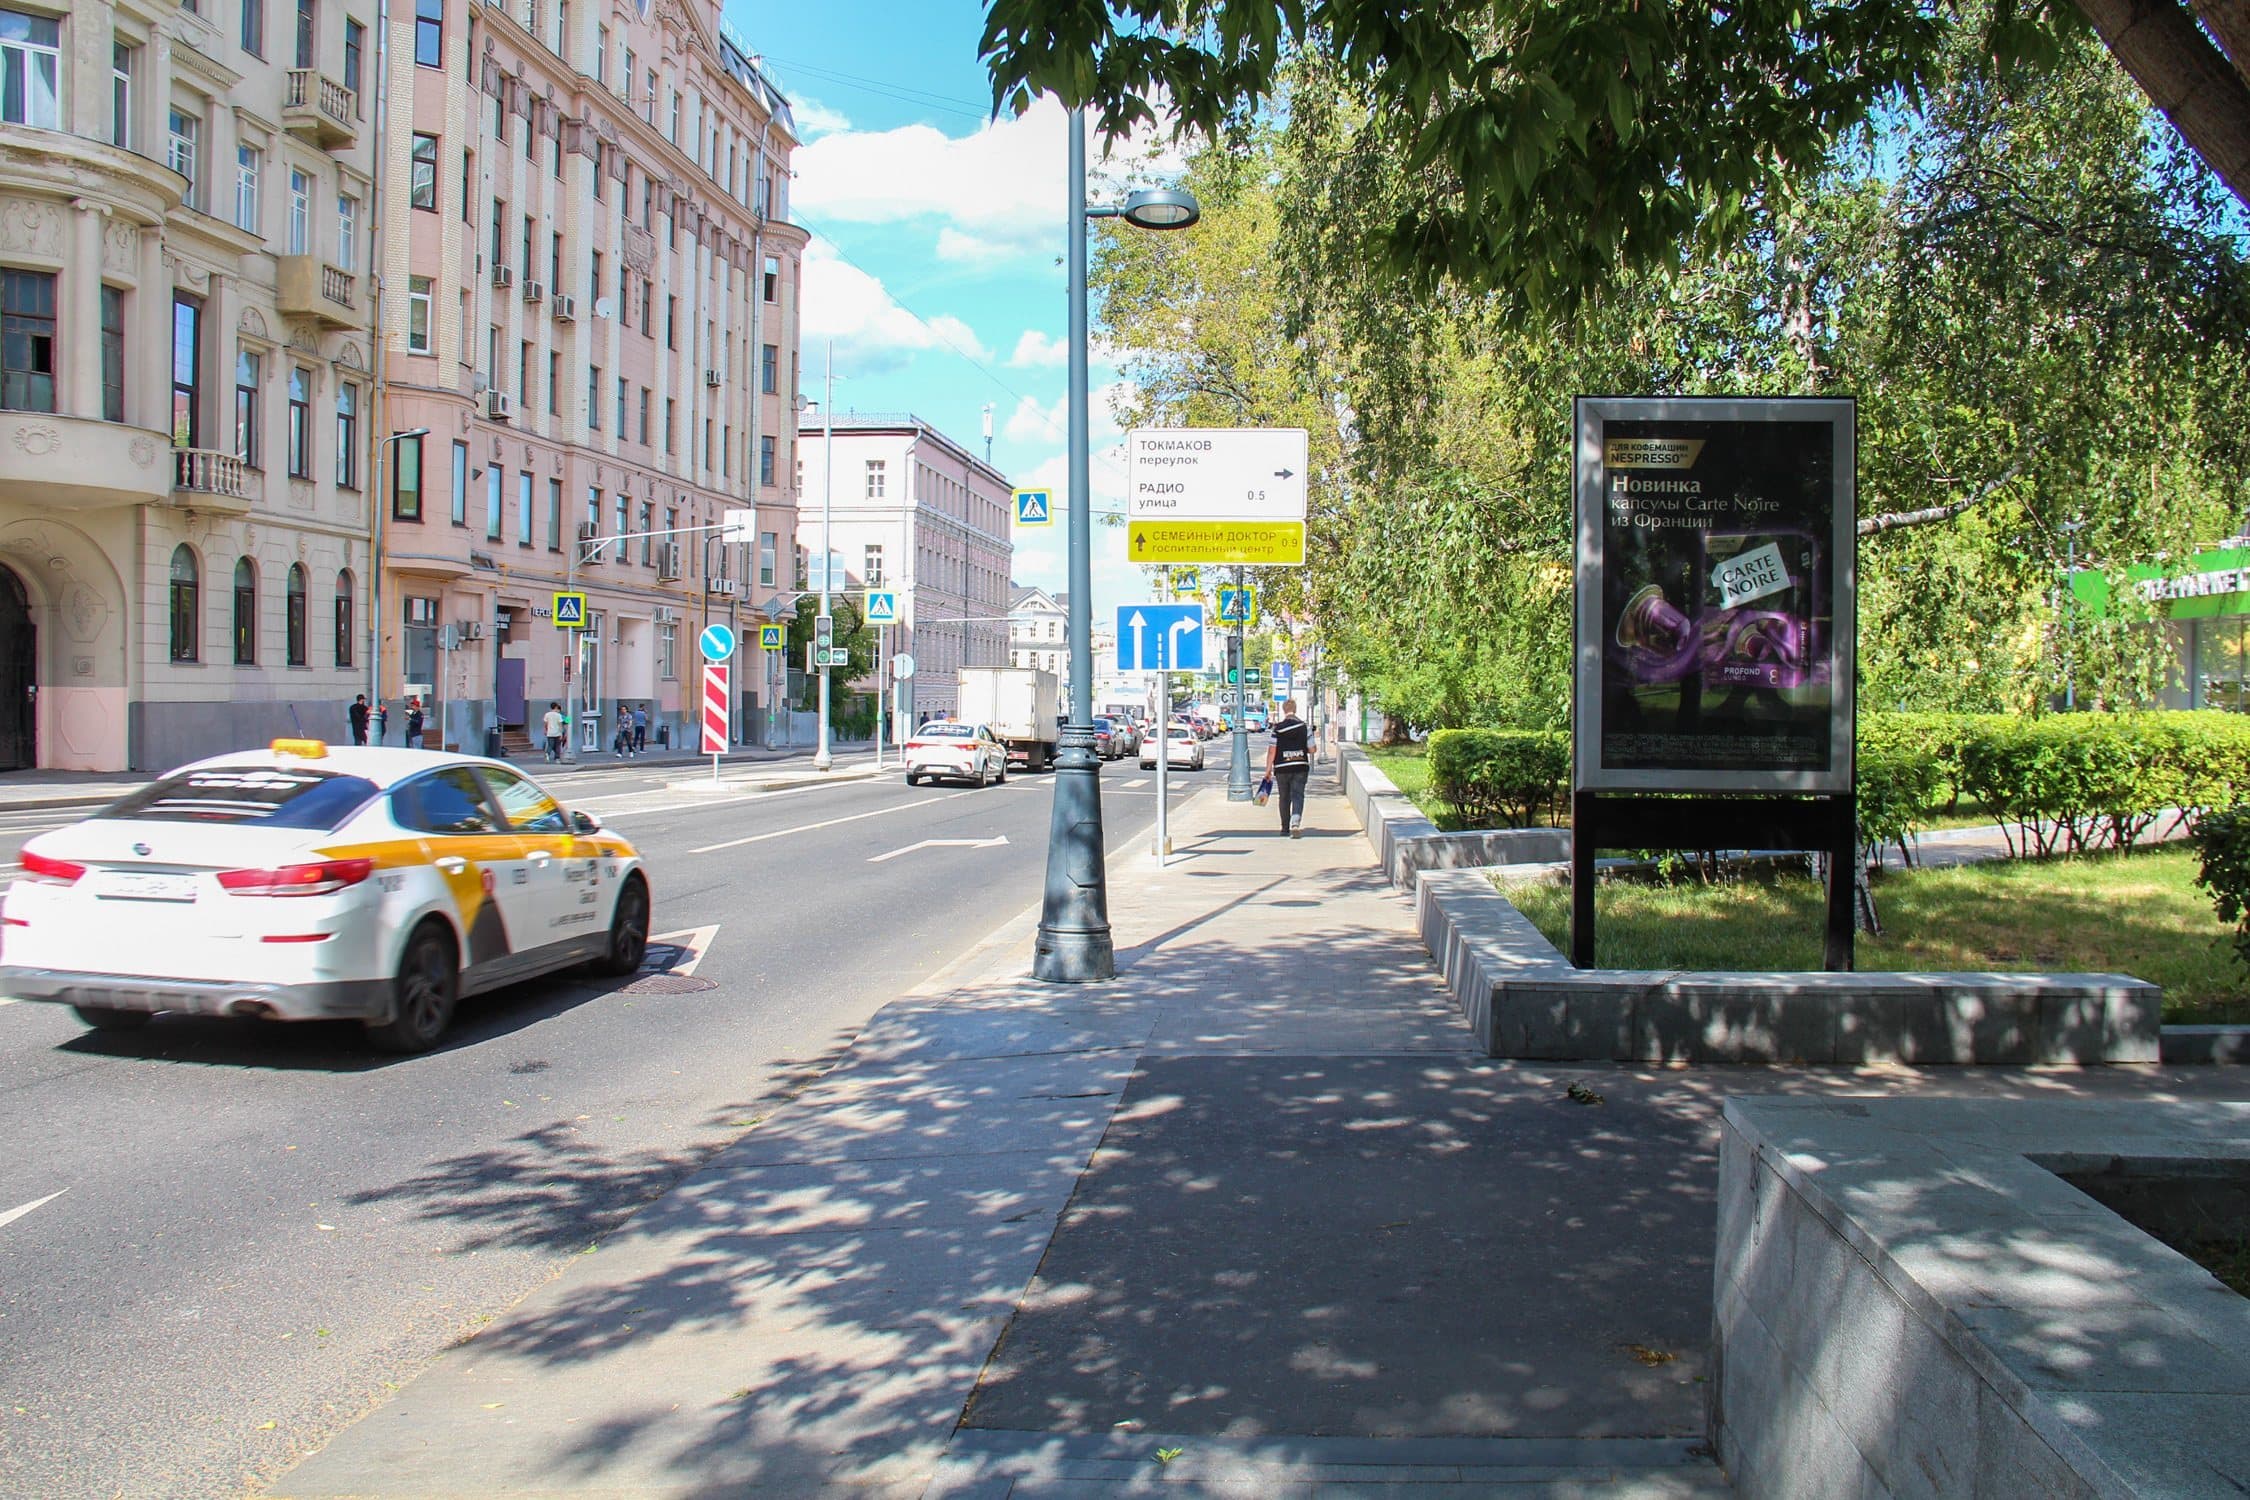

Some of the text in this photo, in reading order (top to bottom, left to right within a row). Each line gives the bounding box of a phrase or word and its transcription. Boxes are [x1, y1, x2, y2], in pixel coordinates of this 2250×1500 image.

[1140, 440, 1212, 451] ТОКМАКОВ
[1611, 443, 1689, 452] ДЛЯ КОФЕМАШИН
[1139, 456, 1198, 466] переулок
[1139, 482, 1185, 494] РАДИО
[1612, 475, 1701, 493] Новинка
[1247, 490, 1266, 501] 0.5
[1139, 499, 1177, 509] улица
[1611, 499, 1679, 514] капсулы
[1685, 496, 1728, 512] Carte
[1611, 513, 1713, 531] из Франции
[1227, 531, 1277, 543] ДОКТОР
[1722, 554, 1775, 583] CARTE
[1727, 569, 1780, 598] NOIRE
